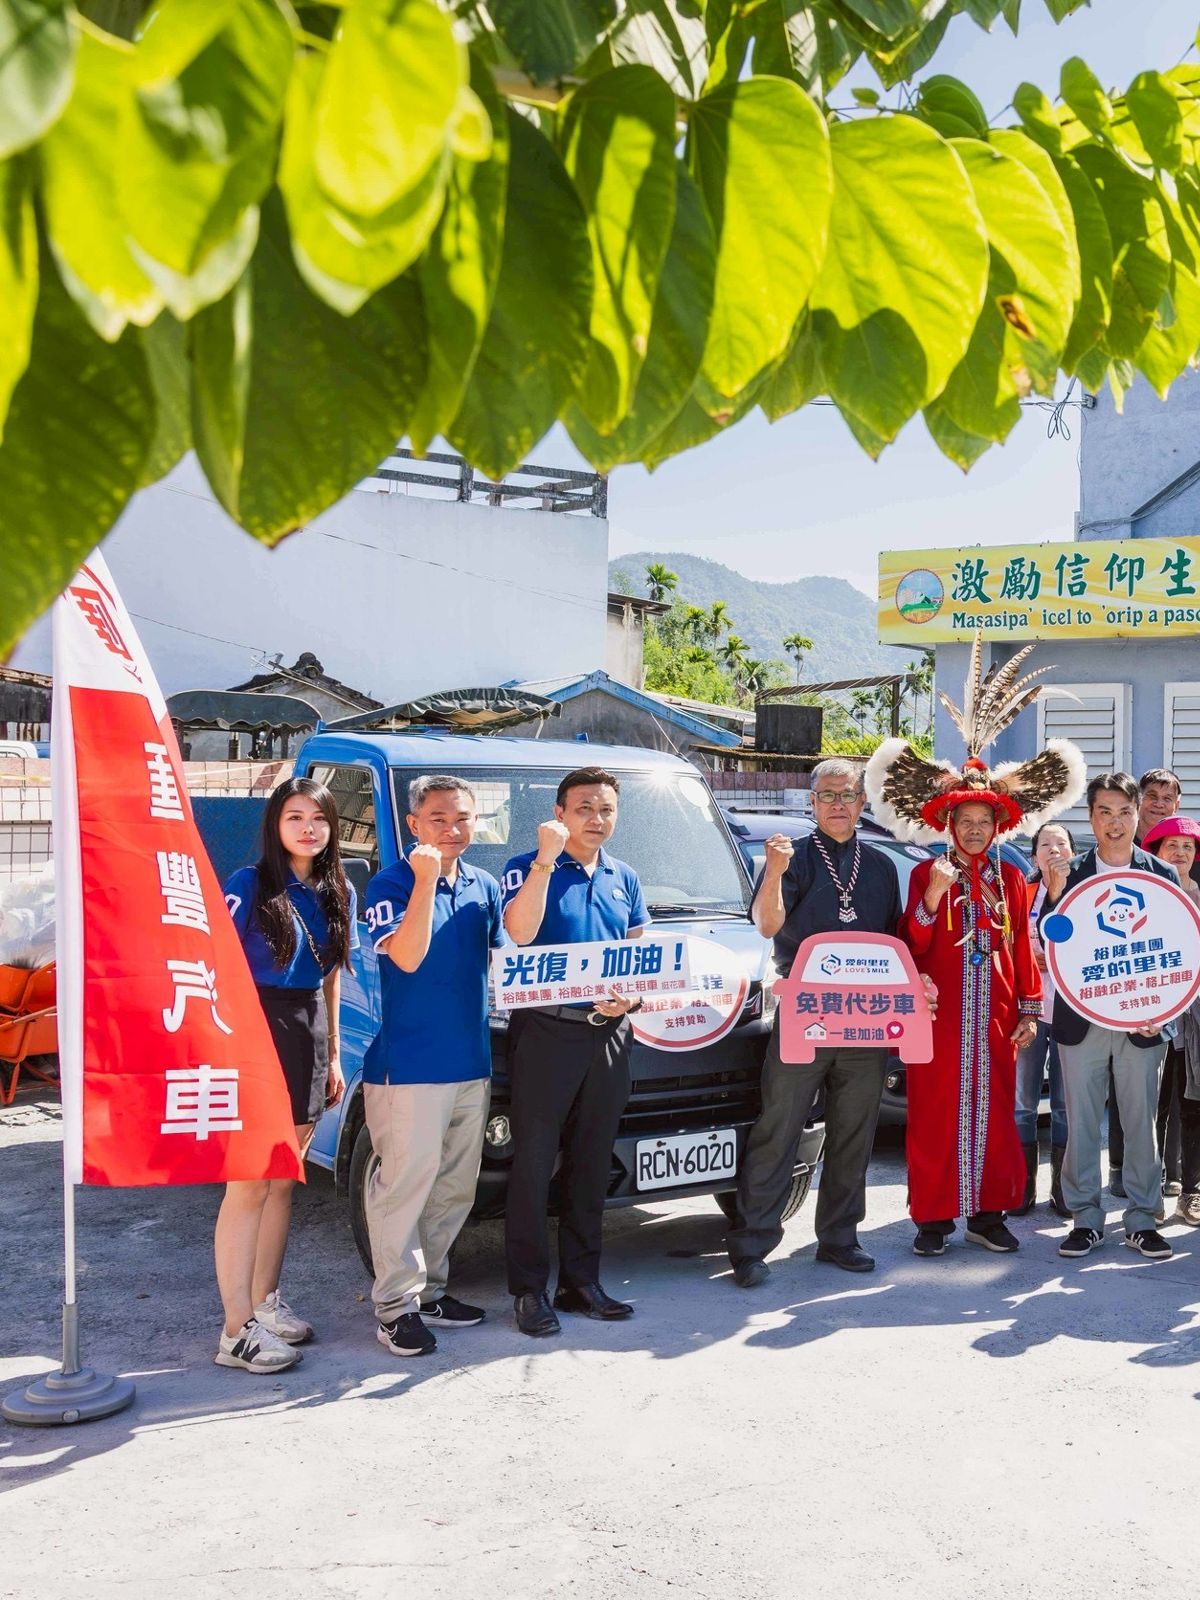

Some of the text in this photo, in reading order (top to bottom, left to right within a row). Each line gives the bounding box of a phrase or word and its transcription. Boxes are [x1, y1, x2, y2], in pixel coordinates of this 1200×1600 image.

[1042, 610, 1072, 626] icel
[1077, 612, 1093, 625] to
[1148, 611, 1159, 624] a
[365, 900, 394, 934] 30
[1094, 938, 1164, 961] 裕隆集團
[1081, 950, 1183, 983] 愛的里程
[796, 992, 915, 1015] 免費代步車
[829, 1027, 885, 1041] 一起加油
